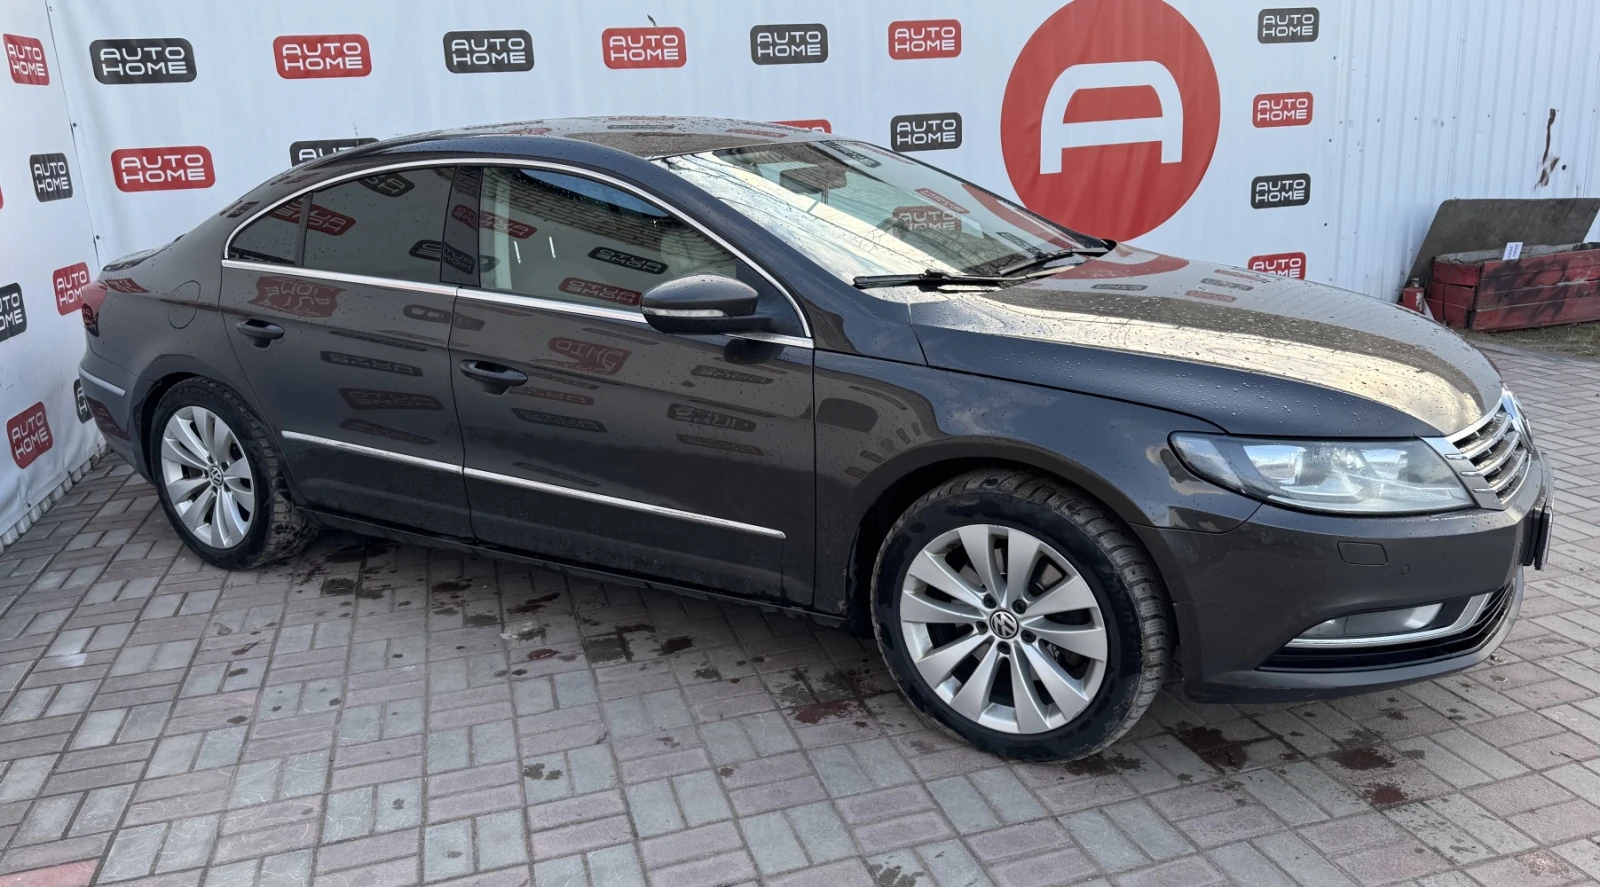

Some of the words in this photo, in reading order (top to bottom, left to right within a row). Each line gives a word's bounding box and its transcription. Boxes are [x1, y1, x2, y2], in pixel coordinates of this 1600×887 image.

[1263, 14, 1314, 25] AUTO
[757, 31, 821, 44] AUTO
[895, 26, 955, 39] AUTO
[1262, 26, 1313, 36] HOME
[452, 38, 525, 51] AUTO
[610, 35, 678, 48] AUTO
[895, 40, 955, 52] HOME
[8, 44, 42, 60] AUTO
[100, 47, 185, 61] AUTO
[282, 42, 361, 56] AUTO
[610, 48, 679, 61] HOME
[758, 44, 821, 57] HOME
[284, 56, 362, 71] HOME
[453, 52, 526, 65] HOME
[12, 61, 45, 76] HOME
[102, 62, 187, 76] HOME
[1258, 98, 1308, 110] AUTO
[1258, 109, 1307, 121] HOME
[897, 120, 956, 133] AUTO
[897, 132, 955, 145] HOME
[121, 154, 203, 169] AUTO
[34, 162, 66, 177] AUTO
[122, 168, 205, 184] HOME
[37, 177, 69, 193] HOME
[1256, 179, 1306, 191] AUTO
[1256, 190, 1304, 202] HOME
[909, 222, 955, 230] OME
[1253, 258, 1301, 271] AUTO
[57, 270, 87, 291] AUTO
[0, 309, 23, 331] OME
[12, 412, 44, 442] AUTO
[15, 428, 48, 459] HOME
